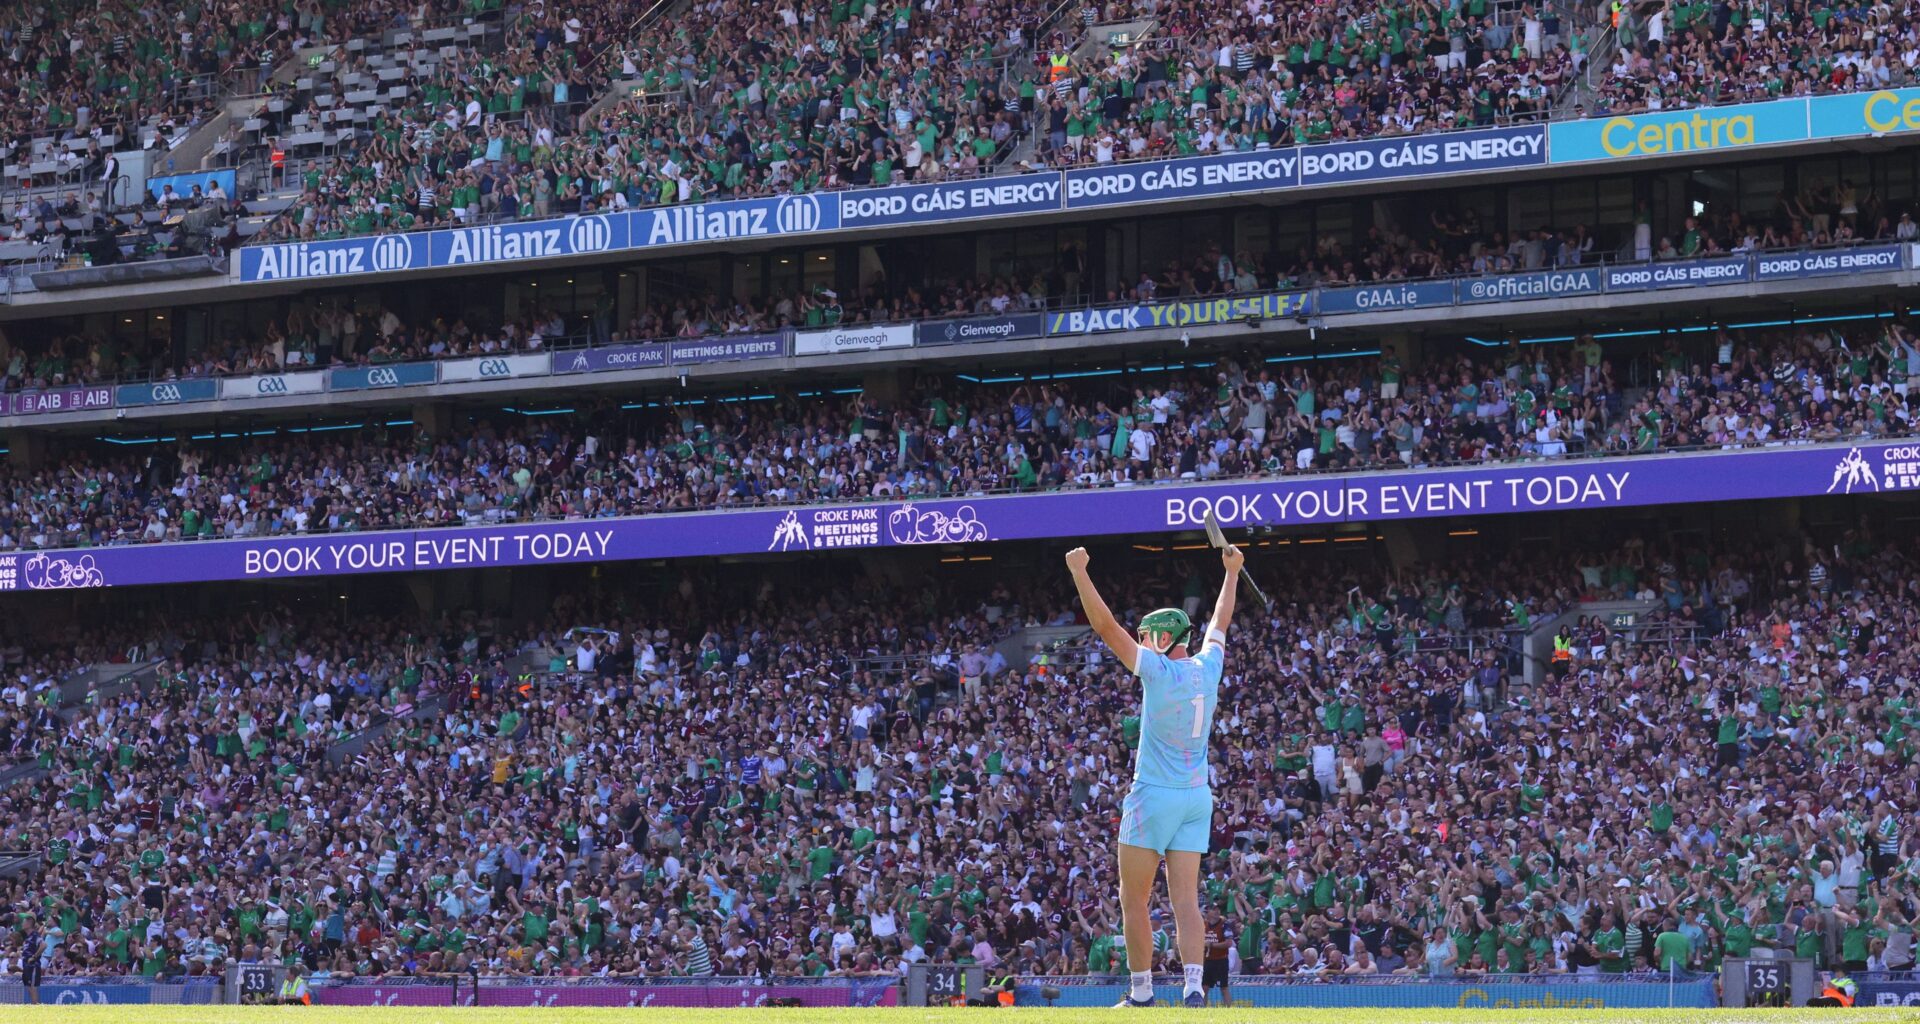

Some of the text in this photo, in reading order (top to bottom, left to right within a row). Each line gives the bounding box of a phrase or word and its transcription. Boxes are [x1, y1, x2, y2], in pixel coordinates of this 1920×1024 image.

[1601, 113, 1754, 156] Centra
[1302, 134, 1543, 176] BORD GÁIS ENERGY
[1067, 157, 1296, 199] BORD GÁIS ENERGY
[842, 180, 1060, 219] BORD GÁIS ENERGY
[649, 205, 767, 245] Allianz
[448, 227, 561, 264] Allianz
[257, 244, 364, 279] Allianz
[1760, 252, 1896, 274] BORD GÁIS ENERGY
[1612, 264, 1744, 285] BORD GÁIS ENERGY
[1471, 273, 1591, 298] @officialGAA
[1356, 288, 1417, 307] GAA.ie
[960, 321, 1015, 336] Glenveagh
[673, 341, 776, 359] MEETINGS & EVENTS
[835, 332, 888, 347] Glenveagh
[607, 350, 663, 364] CROKE PARK
[38, 394, 62, 409] AIB
[85, 390, 109, 406] AIB
[1884, 476, 1895, 488] &
[1167, 472, 1630, 525] BOOK YOUR EVENT TODAY
[814, 508, 878, 522] CROKE PARK
[814, 522, 878, 536] MEETINGS
[814, 534, 878, 547] & EVENTS
[245, 530, 613, 574] BOOK YOUR EVENT TODAY
[1191, 693, 1205, 738] 1
[247, 973, 265, 990] 33
[934, 973, 955, 991] 34
[1753, 968, 1779, 989] 35
